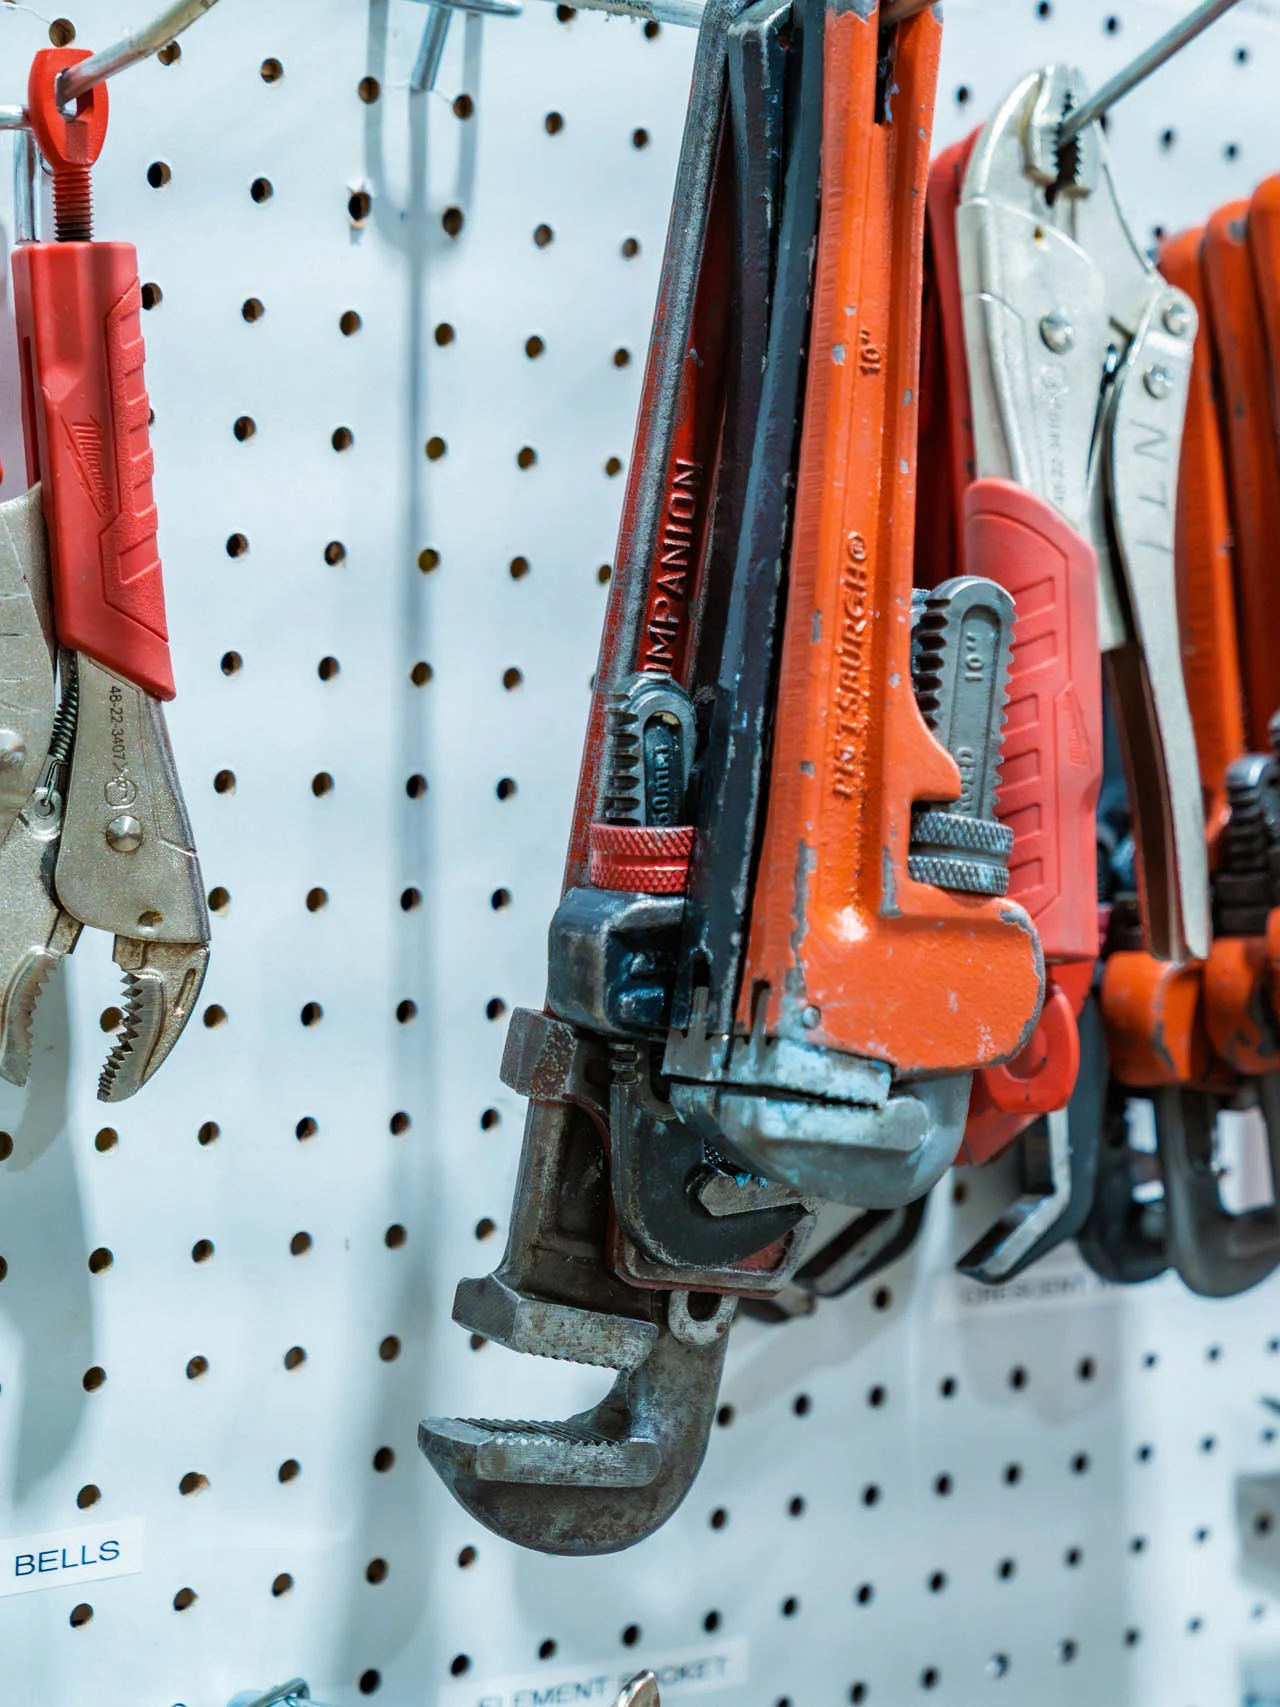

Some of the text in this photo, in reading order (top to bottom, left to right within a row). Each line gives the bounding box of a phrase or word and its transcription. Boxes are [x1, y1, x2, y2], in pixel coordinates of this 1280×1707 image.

[964, 631, 985, 683] 10"
[109, 685, 126, 761] 48-22-3407
[15, 1540, 120, 1577] BELLS
